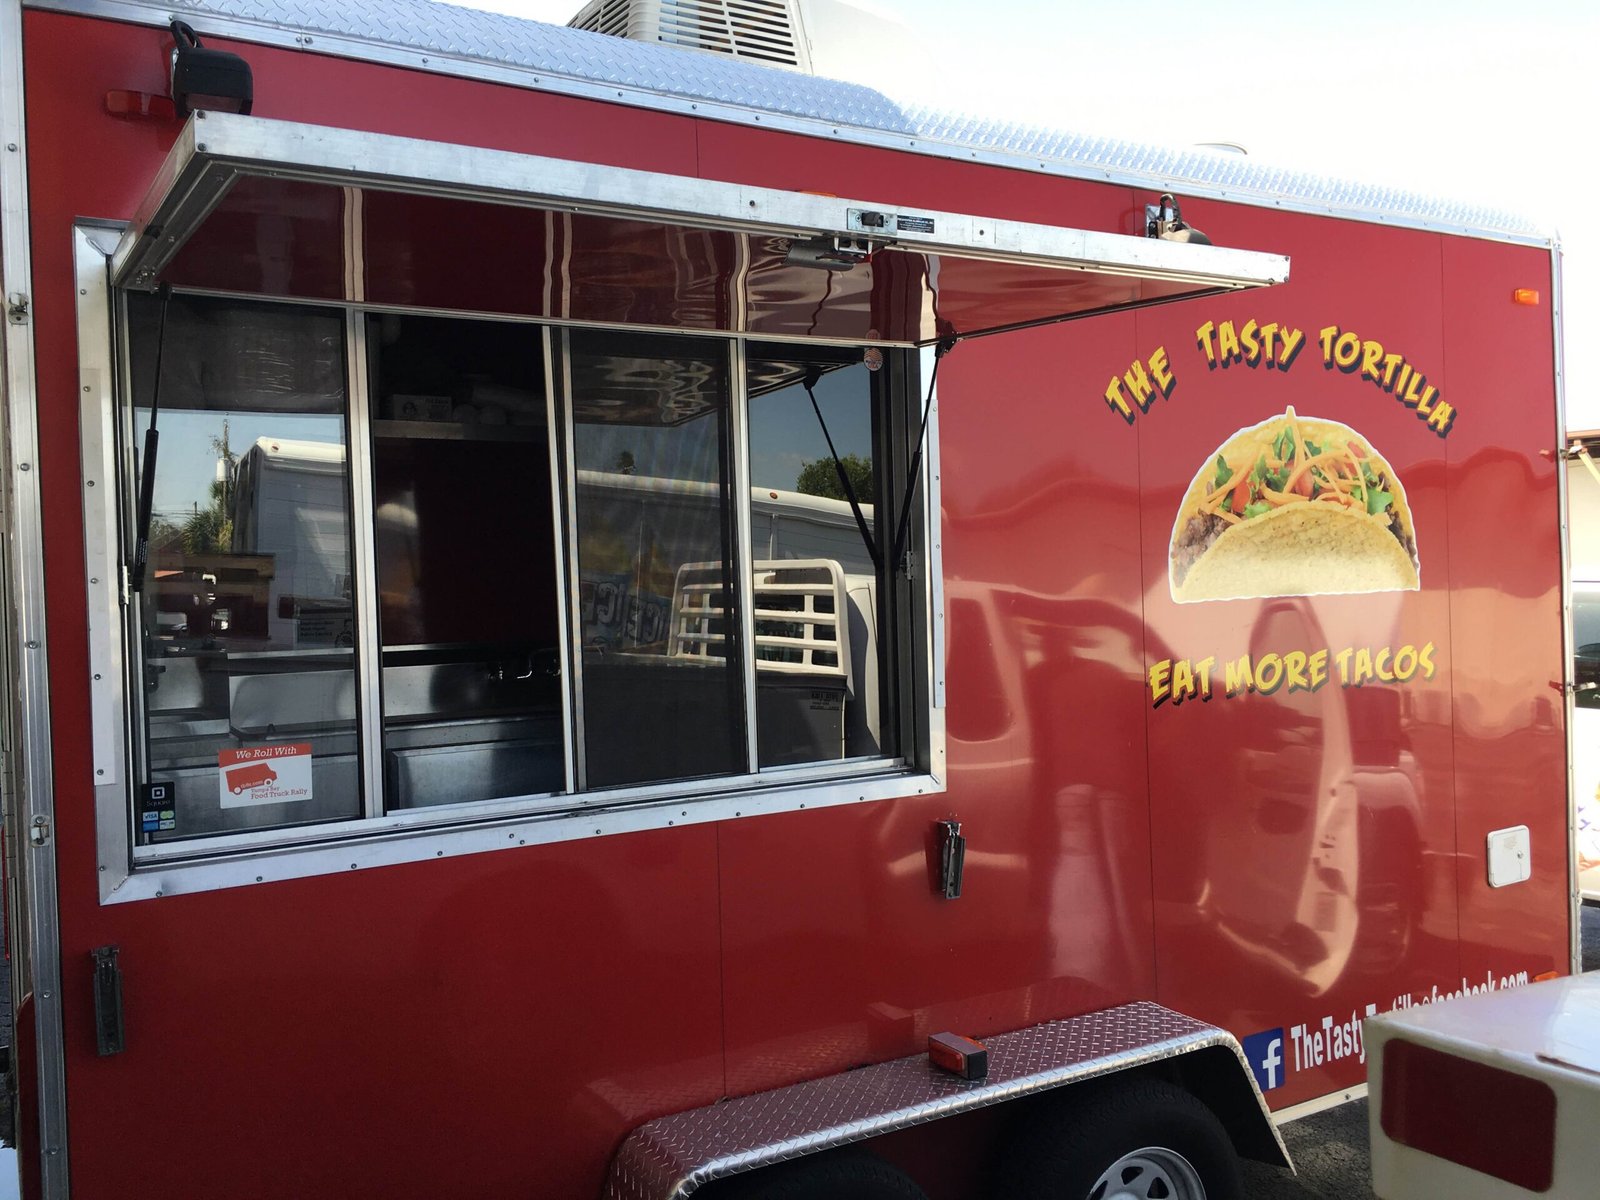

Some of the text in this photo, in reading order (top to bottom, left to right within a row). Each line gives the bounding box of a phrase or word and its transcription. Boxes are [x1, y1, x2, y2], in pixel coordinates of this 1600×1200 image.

[1104, 319, 1458, 438] THE TASTY TORTILLA
[1148, 641, 1437, 709] EAT MORE TACOS
[235, 746, 297, 759] We Roll With
[251, 787, 308, 800] Food Truck Rally
[144, 812, 158, 820] VISA
